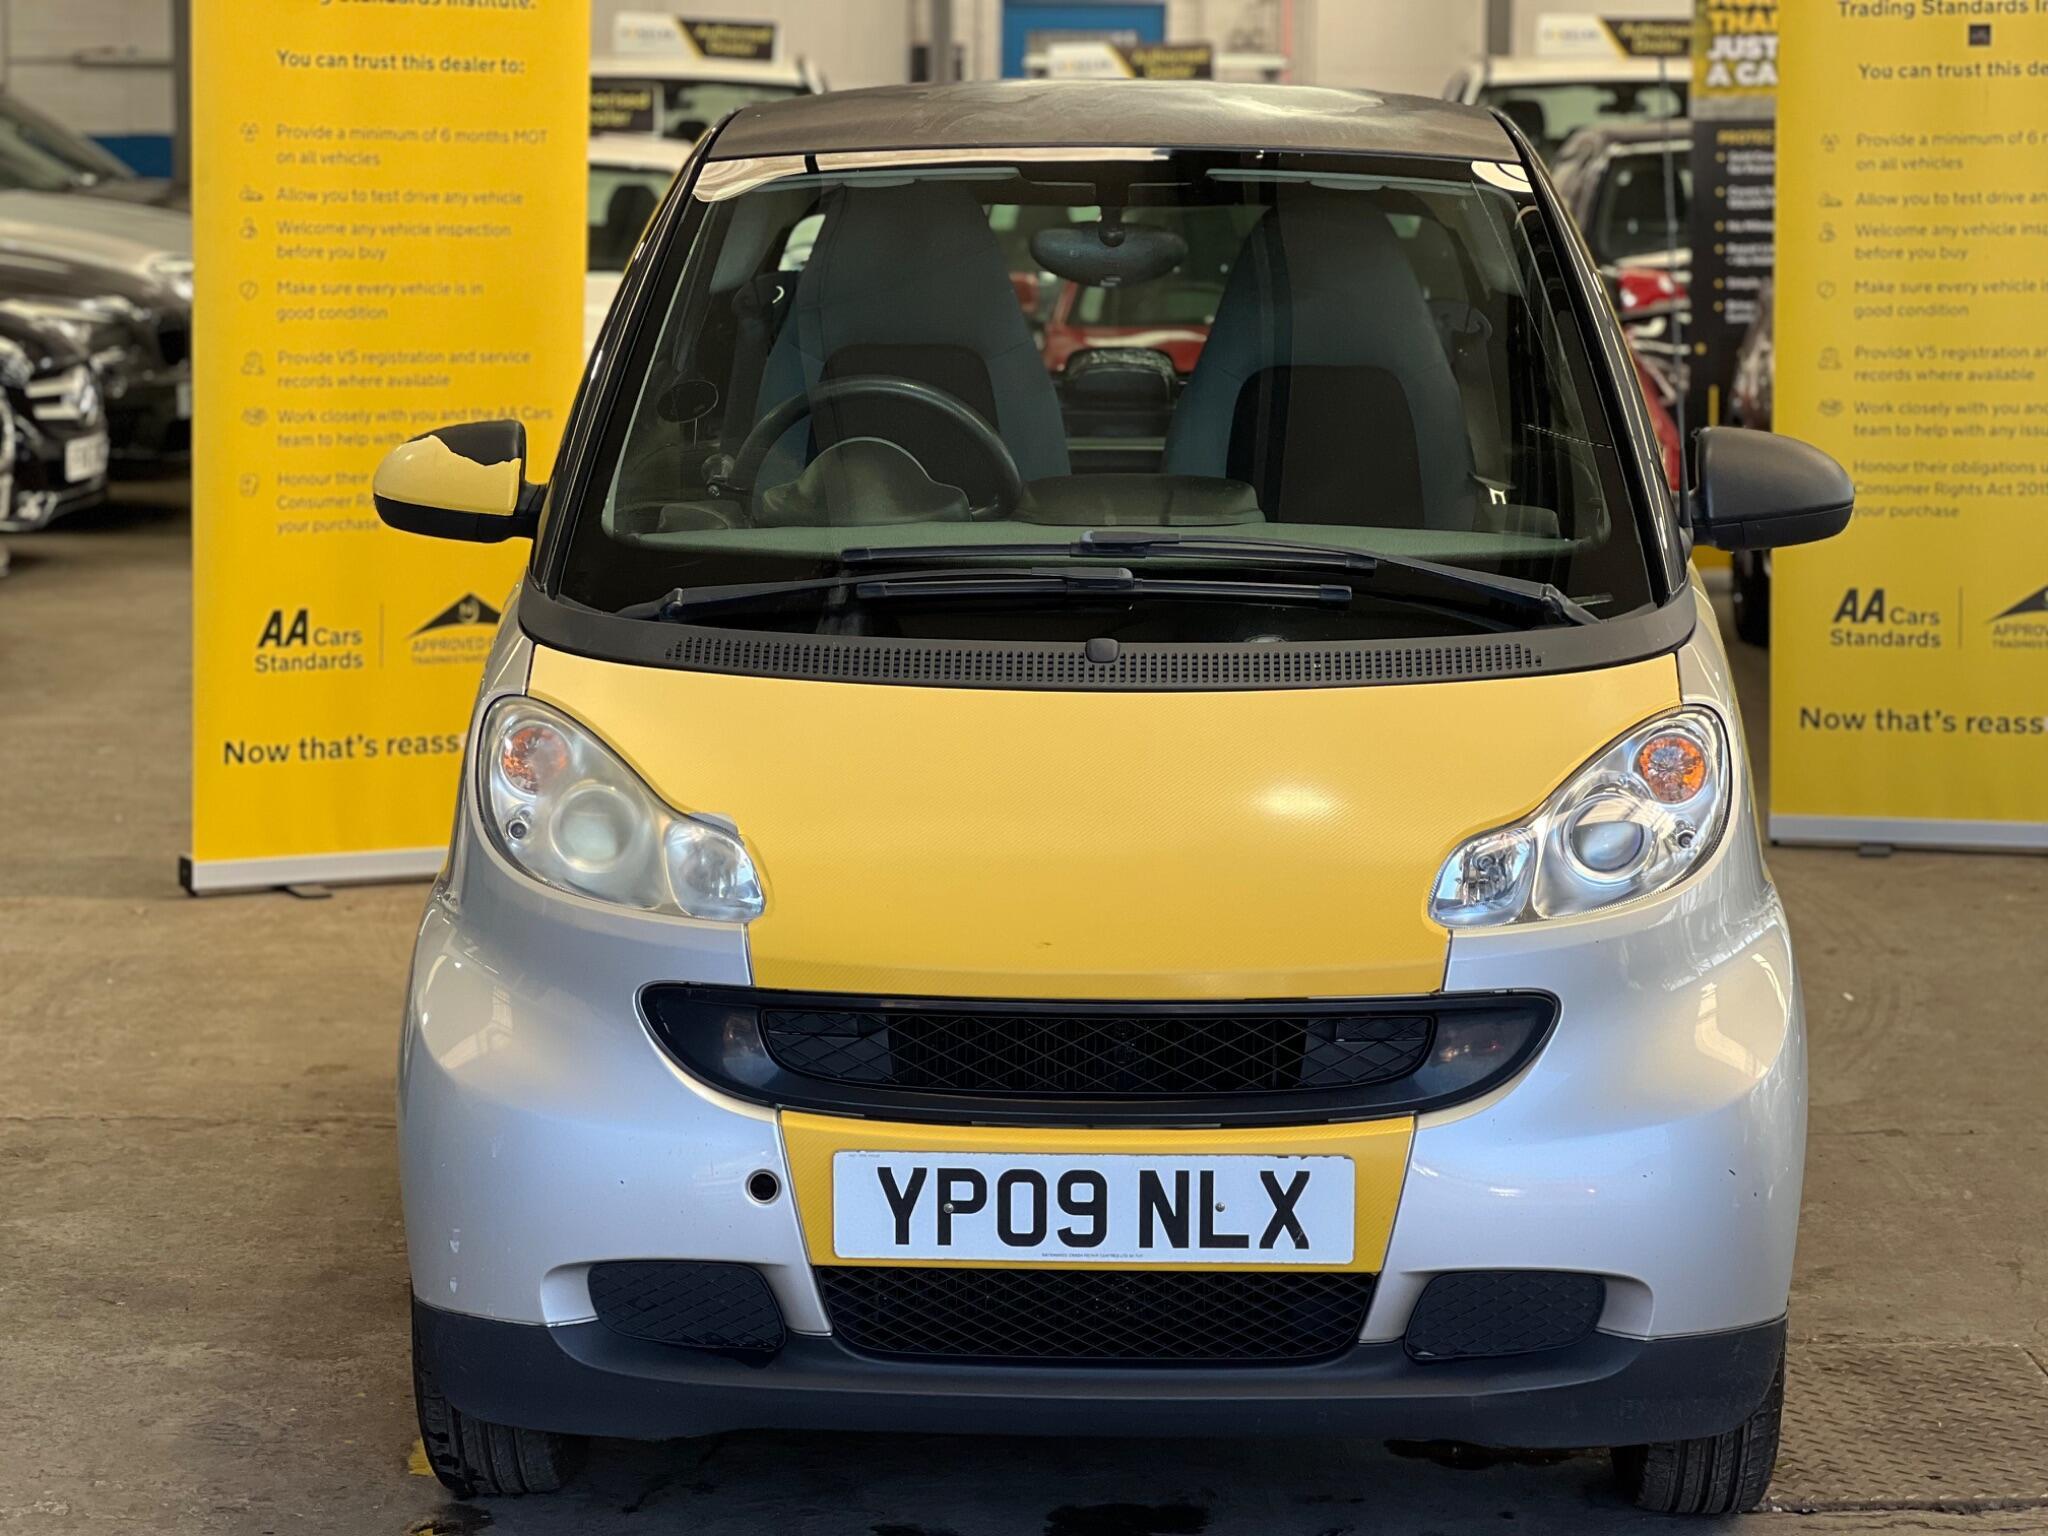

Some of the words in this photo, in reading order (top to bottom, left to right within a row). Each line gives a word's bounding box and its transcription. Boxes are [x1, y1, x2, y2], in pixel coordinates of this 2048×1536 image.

[1840, 0, 1915, 19] Trading
[1922, 0, 2028, 15] Standards
[1707, 36, 1777, 60] JUST
[277, 50, 311, 67] You
[316, 55, 348, 68] can
[353, 54, 396, 70] trust
[402, 55, 435, 71] this
[440, 57, 496, 72] dealer
[500, 58, 524, 74] to:
[1858, 64, 1893, 79] You
[1898, 66, 1932, 79] can
[1937, 63, 1981, 78] trust
[1987, 62, 2021, 77] this
[276, 123, 333, 140] Provide
[349, 129, 419, 141] minimum
[421, 127, 437, 142] of
[440, 128, 451, 143] 6
[455, 130, 510, 144] months
[513, 129, 547, 144] MOT
[1856, 133, 1915, 147] Provide
[1919, 136, 1928, 146] a
[1931, 133, 2004, 146] minimum
[2007, 131, 2023, 145] of
[2027, 130, 2038, 145] 6
[276, 152, 295, 164] on
[300, 151, 316, 164] all
[321, 151, 381, 166] vehicles
[1856, 160, 1876, 171] on
[1880, 158, 1898, 171] all
[1902, 157, 1963, 170] vehicles
[276, 187, 318, 201] Allow
[322, 191, 349, 205] you
[351, 189, 367, 203] to
[371, 190, 399, 203] test
[403, 190, 440, 204] drive
[444, 192, 468, 206] any
[473, 192, 523, 205] vehicle
[1856, 193, 1898, 206] Allow
[1903, 194, 1930, 207] you
[1933, 192, 1949, 206] to
[1953, 192, 1982, 205] test
[1986, 192, 2025, 205] drive
[277, 220, 347, 236] Welcome
[351, 224, 376, 238] any
[380, 223, 432, 236] vehicle
[435, 224, 511, 238] inspection
[1855, 224, 1928, 237] Welcome
[1932, 225, 1958, 238] any
[1962, 223, 2016, 236] vehicle
[276, 245, 324, 259] before
[328, 247, 355, 261] you
[358, 246, 386, 262] buy
[1855, 246, 1904, 260] before
[1908, 248, 1936, 261] you
[1939, 246, 1968, 261] buy
[277, 281, 316, 295] Make
[321, 284, 352, 295] sure
[356, 284, 396, 297] every
[400, 283, 451, 295] vehicle
[1854, 281, 1895, 294] Make
[1901, 283, 1933, 294] sure
[1936, 283, 1978, 295] every
[1982, 280, 2036, 293] vehicle
[276, 307, 315, 323] good
[319, 306, 388, 320] condition
[1854, 304, 1894, 320] good
[1897, 304, 1969, 317] condition
[277, 350, 334, 365] Provide
[337, 349, 358, 365] V5
[361, 351, 445, 367] registration
[448, 351, 476, 364] and
[480, 352, 530, 363] service
[1854, 346, 1913, 360] Provide
[1916, 345, 1937, 359] V5
[1941, 347, 2029, 362] registration
[277, 374, 333, 388] records
[337, 375, 383, 388] where
[387, 374, 451, 388] available
[1854, 368, 1912, 382] records
[1916, 369, 1963, 381] where
[1967, 369, 2035, 382] available
[277, 410, 316, 423] Work
[320, 409, 372, 425] closely
[375, 409, 407, 422] with
[410, 411, 437, 424] you
[441, 409, 468, 421] and
[471, 406, 495, 420] the
[520, 406, 553, 420] Cars
[1854, 402, 1894, 414] Work
[1898, 402, 1951, 417] closely
[1955, 402, 1988, 414] with
[1992, 404, 2020, 418] you
[277, 434, 314, 447] team
[318, 433, 333, 447] to
[337, 433, 370, 447] help
[372, 432, 406, 446] with
[1853, 424, 1892, 436] team
[1895, 424, 1912, 437] to
[1915, 424, 1948, 438] help
[1952, 424, 1985, 436] with
[1989, 426, 2016, 439] any
[1853, 461, 1910, 474] Honour
[1913, 461, 1948, 474] their
[1951, 461, 2036, 477] obligations
[277, 473, 332, 486] Honour
[335, 472, 369, 485] their
[1853, 482, 1930, 495] Consumer
[1934, 481, 1982, 499] Rights
[1986, 482, 2012, 496] Act
[276, 495, 352, 510] Consumer
[1852, 506, 1886, 519] your
[1889, 505, 1960, 518] purchase
[277, 521, 309, 535] your
[312, 516, 381, 533] purchase
[1833, 588, 1884, 623] AA
[1889, 607, 1940, 626] Cars
[258, 609, 308, 648] AA
[313, 627, 363, 646] Cars
[1830, 629, 1941, 648] Standards
[255, 651, 364, 673] Standards
[1800, 707, 1865, 730] Now
[1875, 709, 1957, 732] that's
[224, 741, 289, 764] Now
[299, 734, 378, 761] that's
[877, 1166, 1108, 1249] YP09
[1139, 1168, 1311, 1250] NLX
